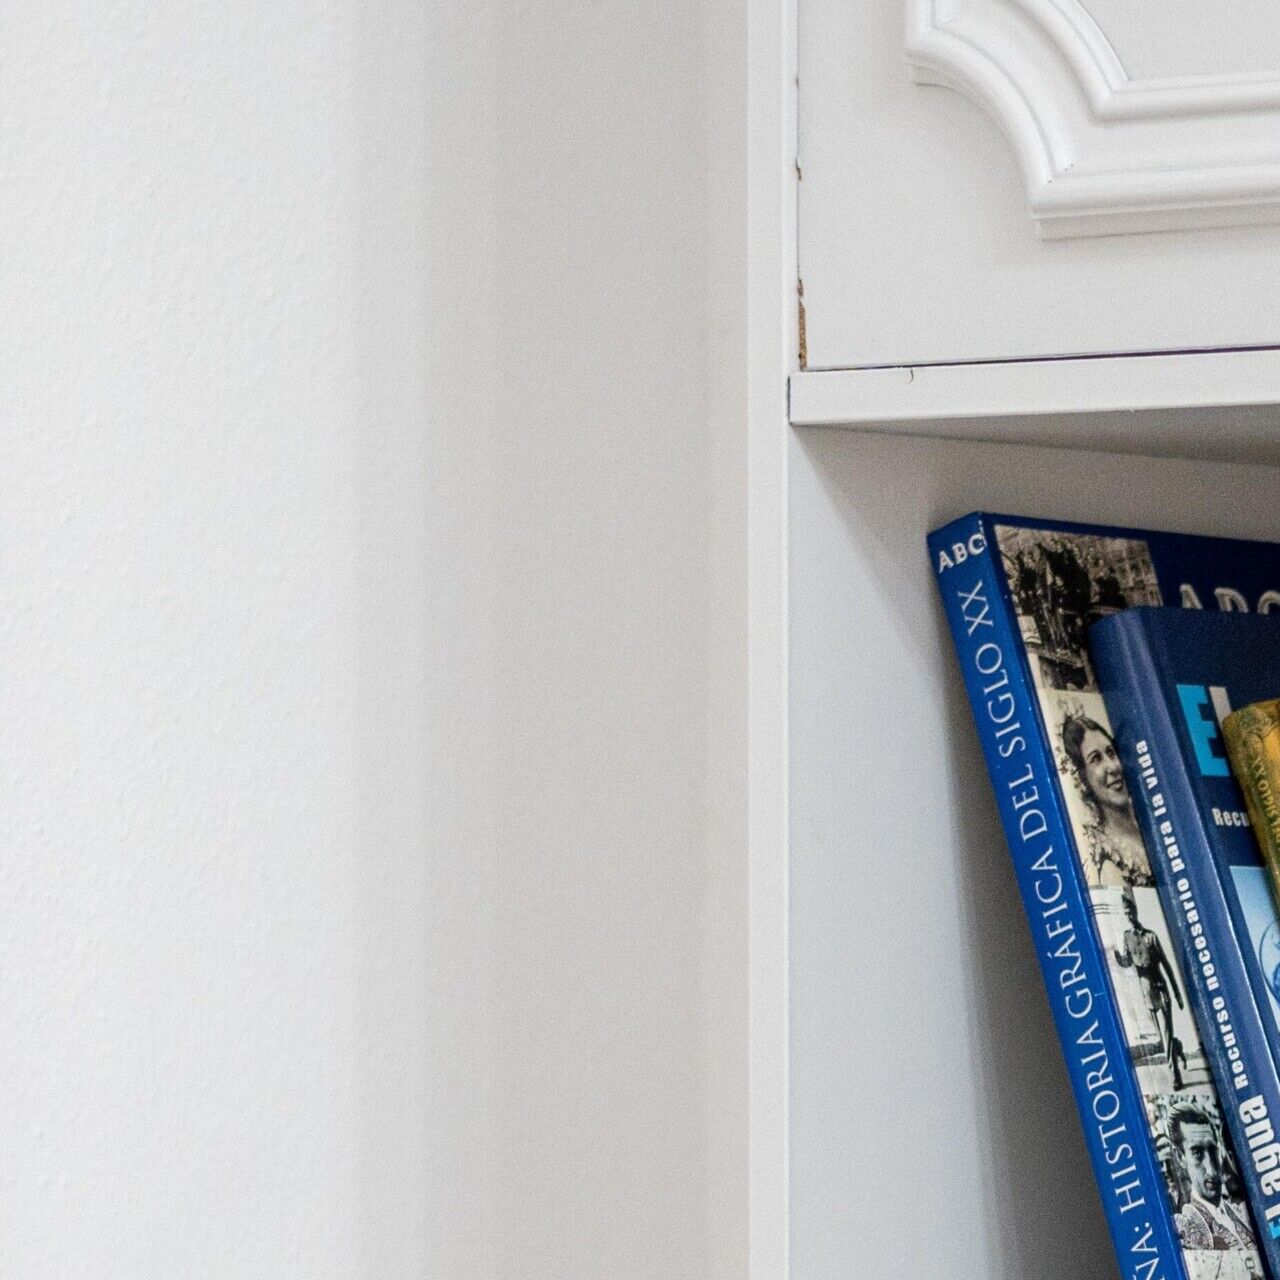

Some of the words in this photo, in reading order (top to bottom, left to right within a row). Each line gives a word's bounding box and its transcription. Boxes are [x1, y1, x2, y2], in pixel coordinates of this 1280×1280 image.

[937, 531, 986, 574] ABC
[957, 580, 993, 635] XX
[975, 642, 1025, 757] SIGLO
[1136, 740, 1157, 788] vida
[1251, 754, 1266, 777] XX
[1008, 763, 1047, 840] DEL
[1152, 793, 1166, 816] la
[1257, 779, 1279, 816] SIGLO
[1160, 820, 1184, 872] para
[1030, 845, 1092, 1018] GRÁFICA
[1177, 878, 1219, 990] necesario
[1212, 996, 1248, 1089] Recurso
[1076, 1020, 1145, 1213] HISTORIA
